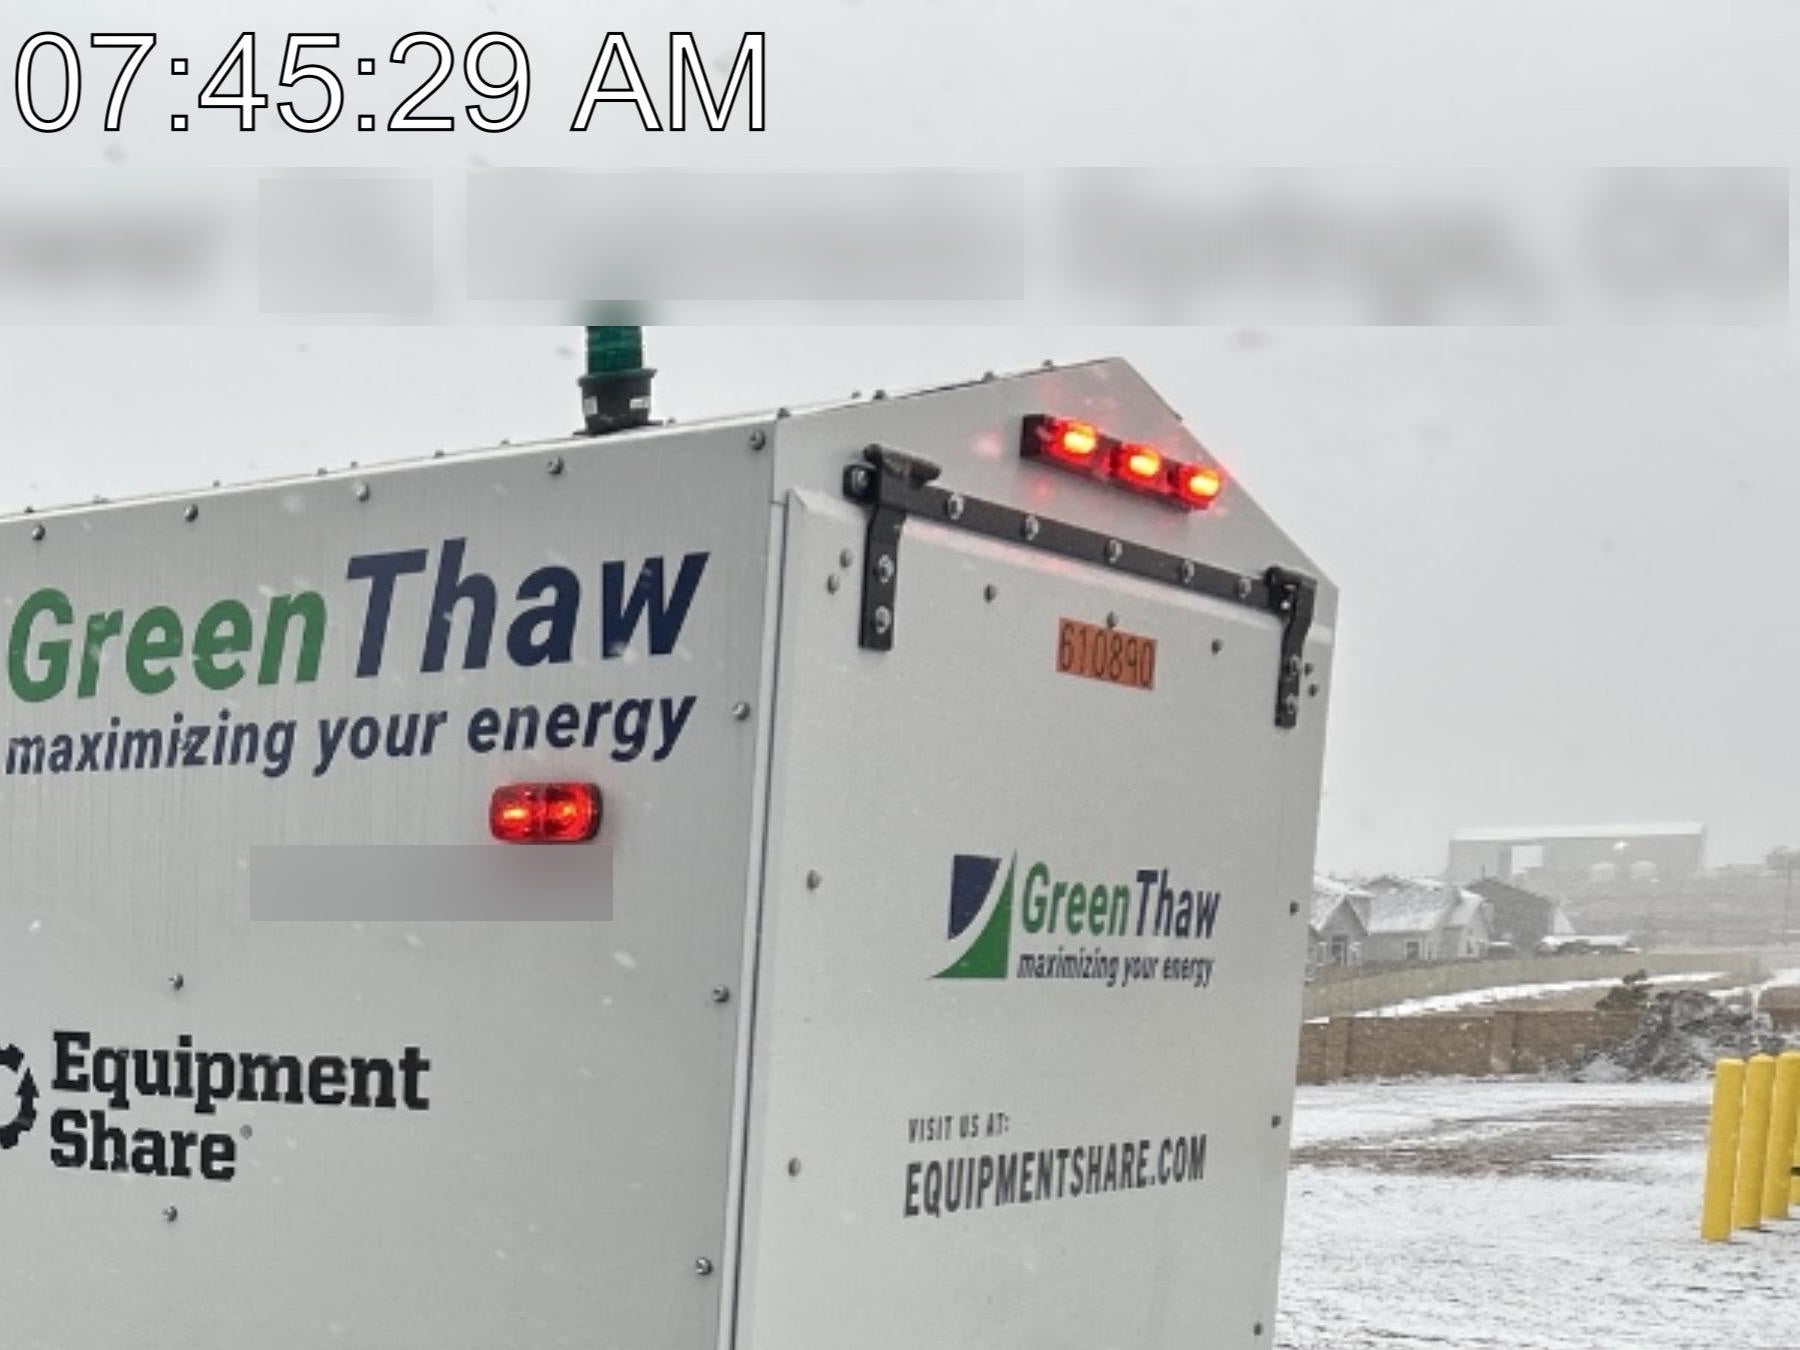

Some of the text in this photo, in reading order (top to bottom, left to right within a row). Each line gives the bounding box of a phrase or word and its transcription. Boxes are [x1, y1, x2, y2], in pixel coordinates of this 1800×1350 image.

[1061, 622, 1153, 688] 610890
[5, 696, 697, 777] maximizing your energy
[1017, 946, 1215, 988] maximizing your energy
[51, 1031, 431, 1114] Equipment
[909, 1112, 1009, 1143] VISIT US AT:
[904, 1134, 1207, 1218] EQUIPMENTSHARE.COM
